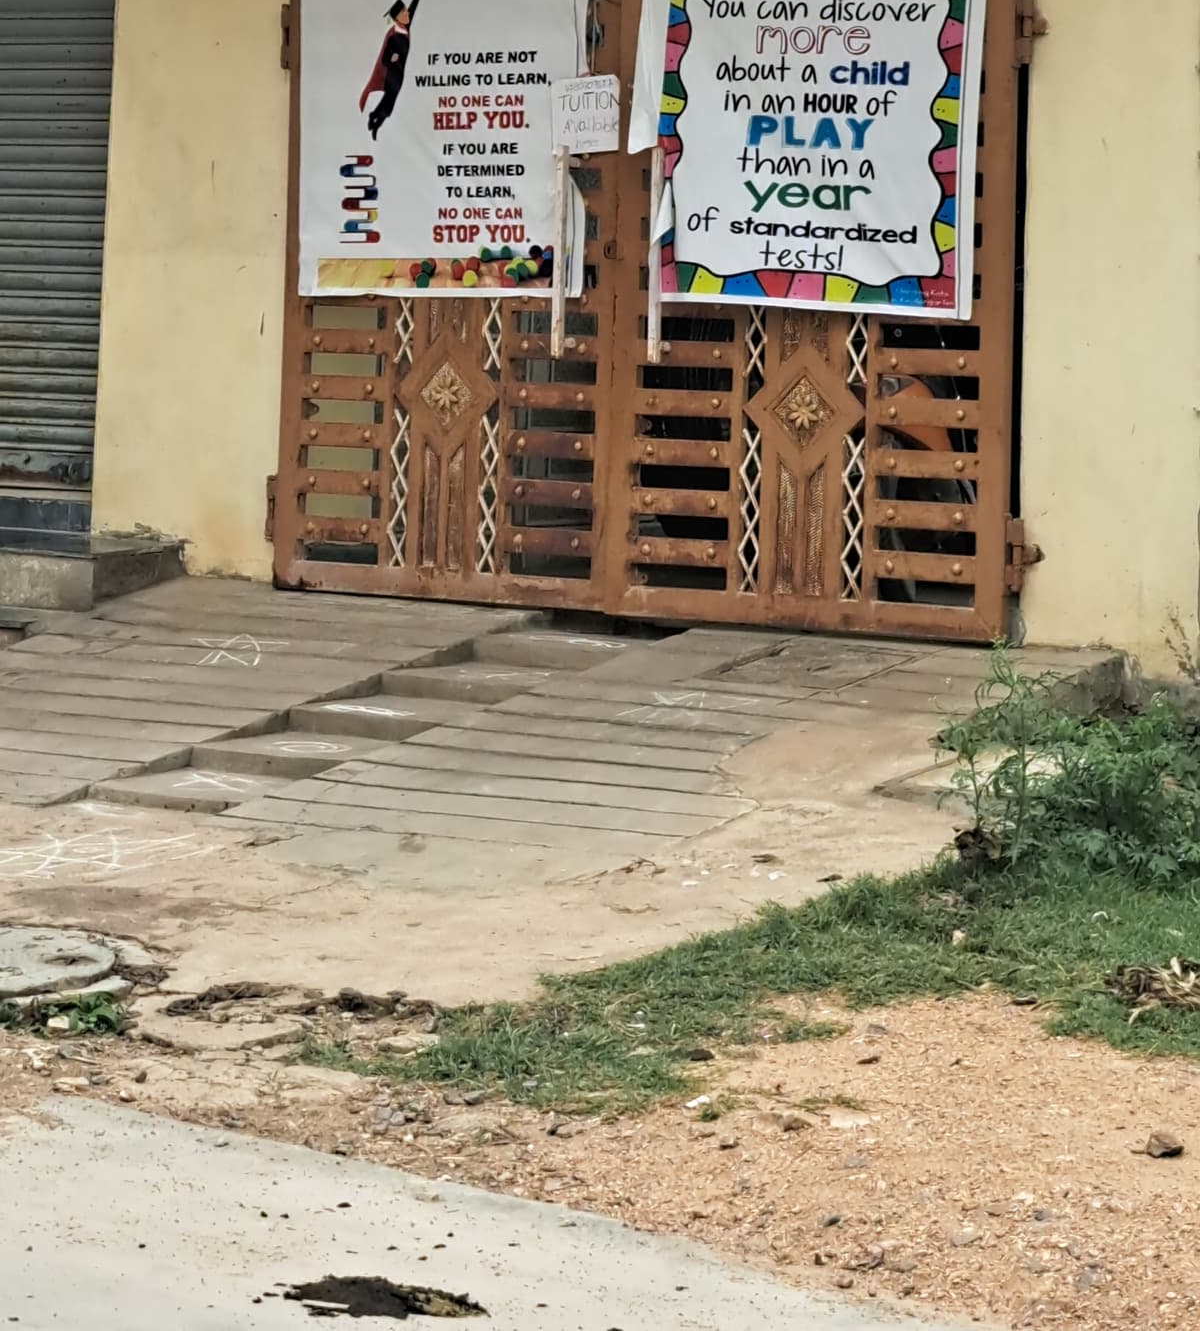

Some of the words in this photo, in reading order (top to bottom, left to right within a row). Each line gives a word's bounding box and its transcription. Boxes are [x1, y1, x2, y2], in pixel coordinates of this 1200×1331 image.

[757, 0, 808, 18] can
[756, 25, 871, 55] more
[428, 54, 440, 65] IF
[444, 53, 471, 64] YOU
[476, 52, 503, 64] ARE
[507, 51, 538, 63] NOT
[415, 75, 471, 87] WILLING
[475, 74, 493, 86] TO
[498, 73, 552, 87] LEARN,
[716, 56, 791, 82] about
[801, 63, 818, 84] a
[830, 61, 909, 86] child
[438, 96, 458, 107] NO
[461, 96, 490, 107] ONE
[494, 95, 524, 107] CAN
[724, 90, 750, 112] in
[761, 93, 794, 112] an
[802, 93, 856, 113] HOUR
[866, 90, 898, 117] of
[432, 112, 478, 130] HELP
[483, 110, 530, 129] YOU.
[746, 116, 874, 150] PLAY
[442, 144, 454, 155] IF
[458, 144, 486, 155] YOU
[491, 143, 519, 154] ARE
[437, 164, 524, 177] DETERMINED
[736, 147, 812, 174] than
[821, 156, 848, 177] in
[859, 162, 875, 180] a
[445, 187, 462, 198] TO
[467, 186, 515, 199] LEARN,
[744, 179, 871, 212] year
[438, 208, 458, 219] NO
[462, 208, 491, 219] ONE
[495, 207, 522, 219] CAN
[432, 226, 479, 243] STOP
[484, 225, 531, 243] YOU.
[688, 206, 720, 232] of
[730, 218, 917, 244] standardized
[759, 240, 844, 270] tests!
